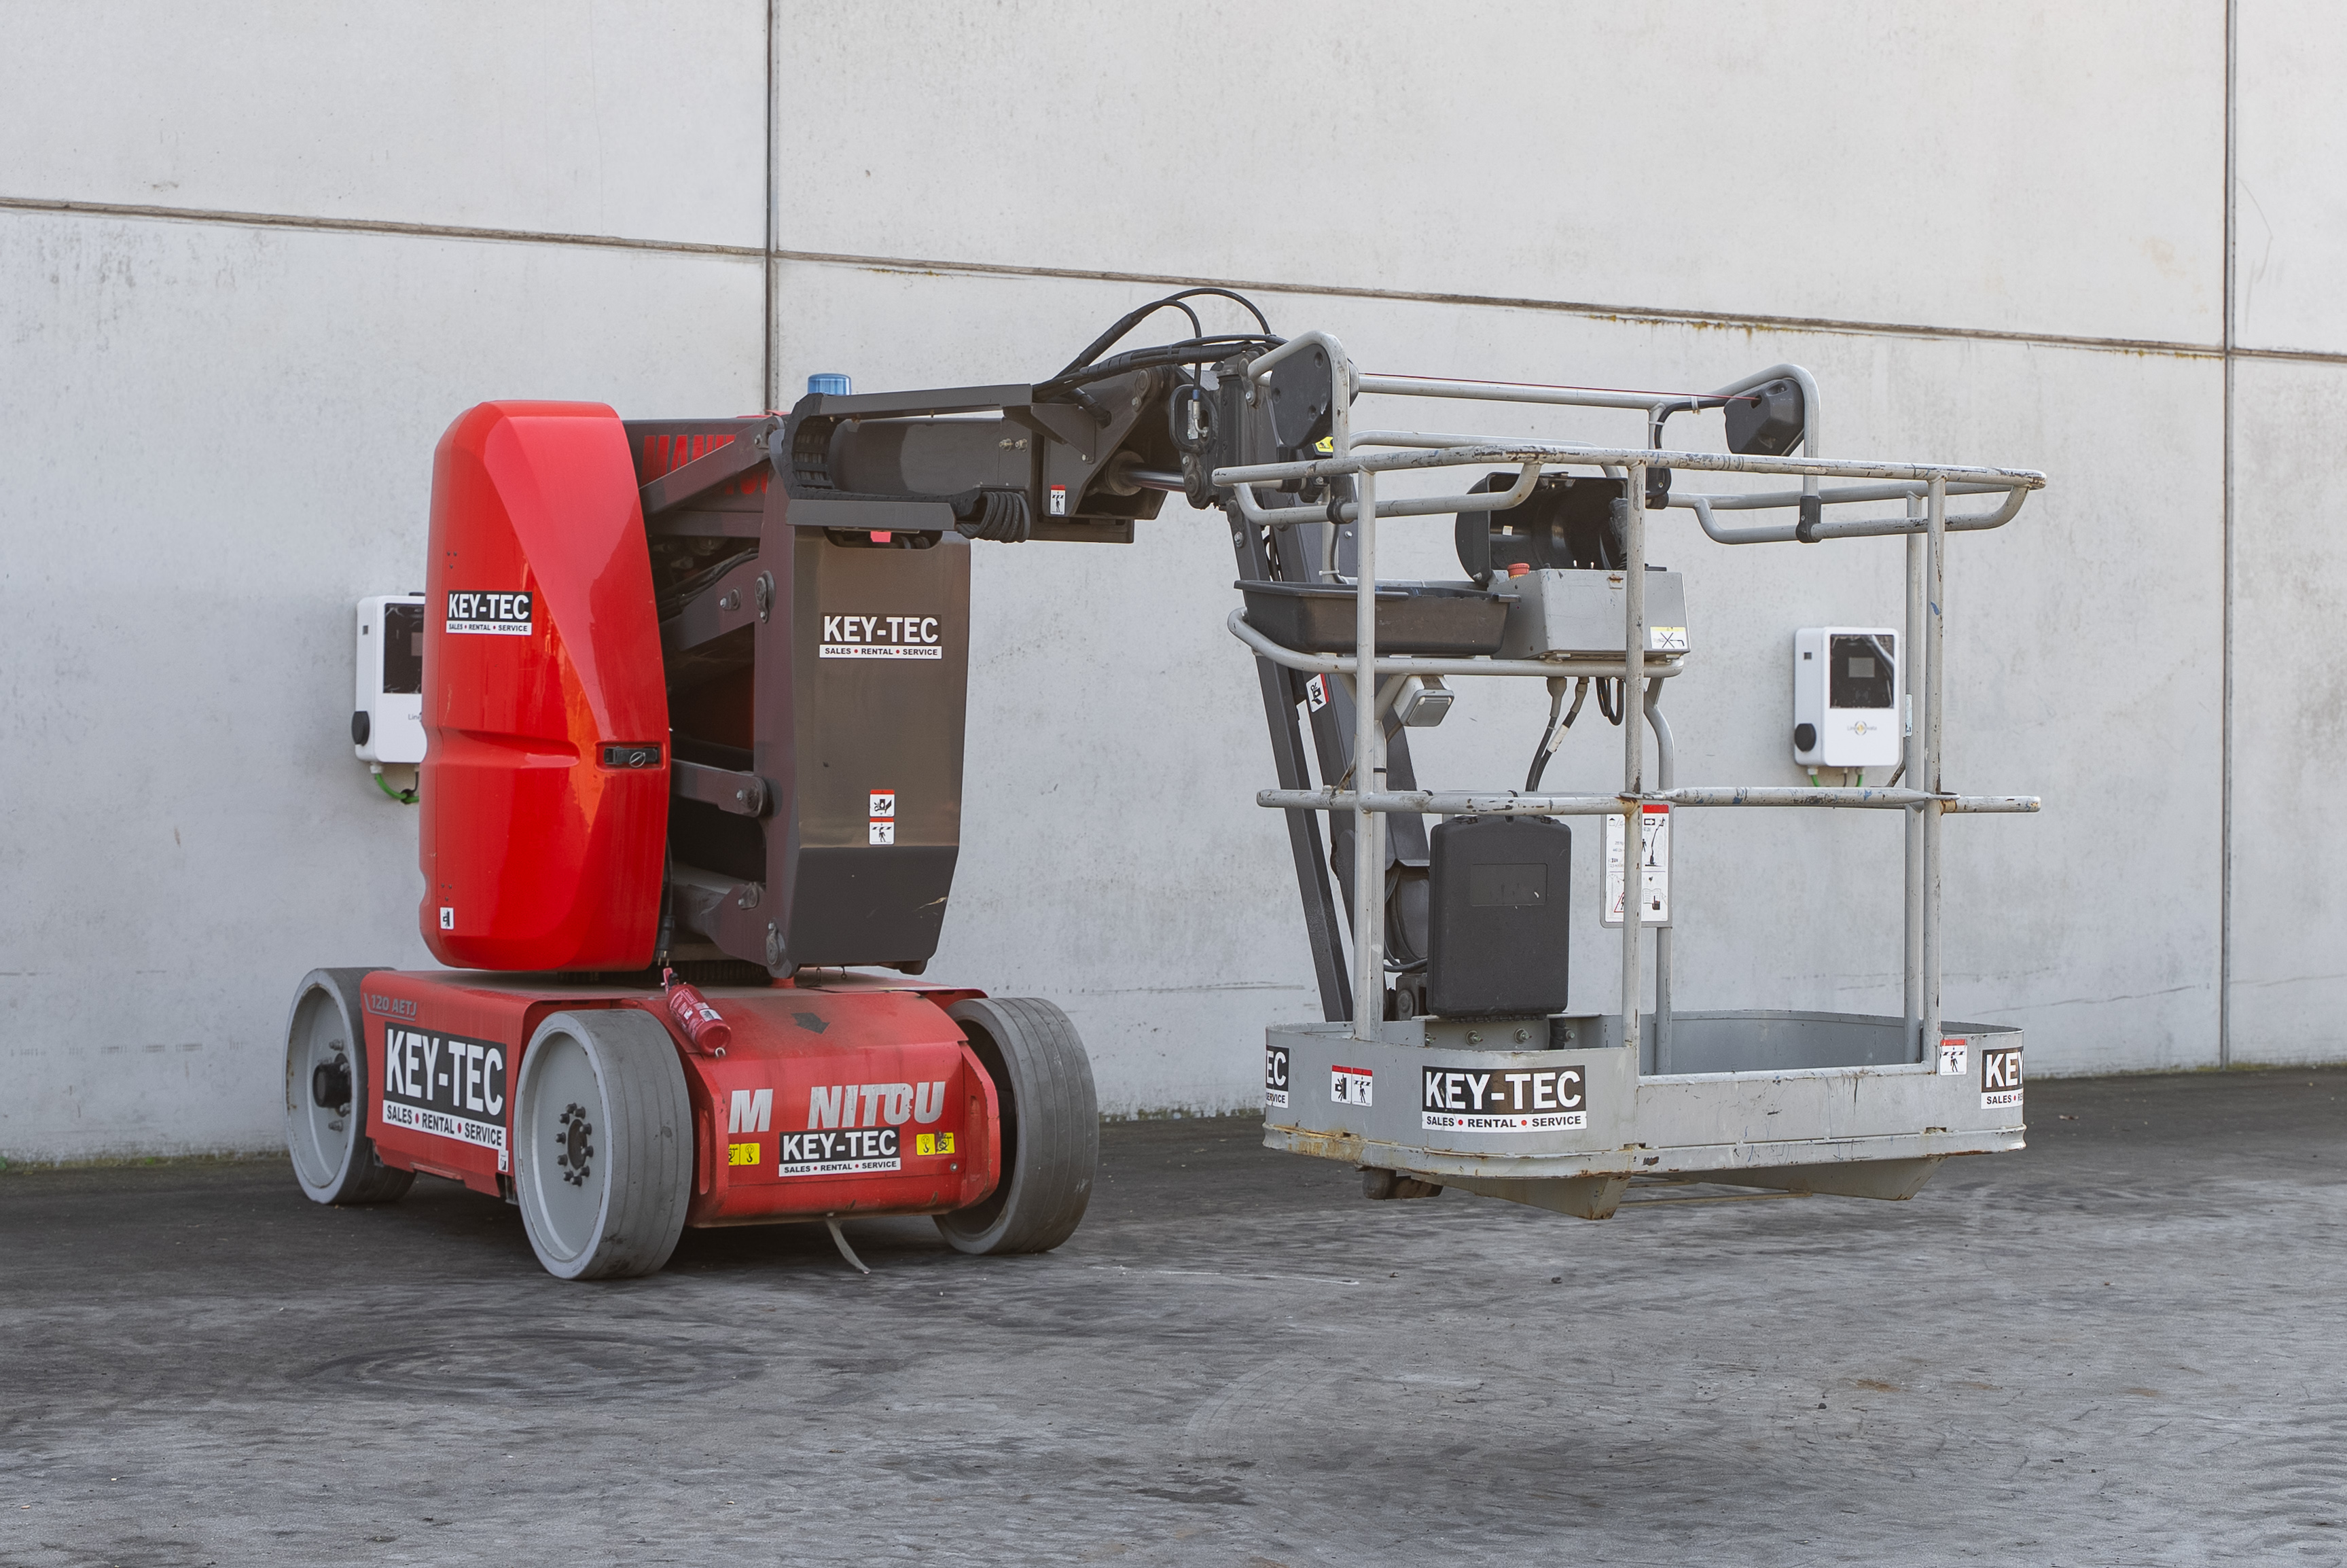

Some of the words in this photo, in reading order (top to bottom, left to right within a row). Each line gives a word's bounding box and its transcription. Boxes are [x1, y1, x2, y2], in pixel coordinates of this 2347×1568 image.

[448, 594, 529, 620] KEY-TEC
[823, 616, 939, 643] KEY-TEC
[371, 994, 390, 1012] 120
[392, 998, 417, 1016] AETJ
[387, 1028, 503, 1116] KEY-TEC
[1266, 1092, 1285, 1103] ERVICE
[1425, 1070, 1582, 1110] KEY-TEC
[1986, 1094, 2012, 1105] SALES
[387, 1104, 412, 1124] SALES
[422, 1113, 454, 1135] RENTAL
[464, 1123, 502, 1147] SERVICE
[1427, 1115, 1455, 1126] SALES
[1467, 1118, 1517, 1128] RENTAL
[1531, 1116, 1581, 1127] SERVICE
[783, 1130, 897, 1160] KEY-TEC
[820, 1163, 853, 1172] RENTAL
[861, 1160, 897, 1169] SERVICE
